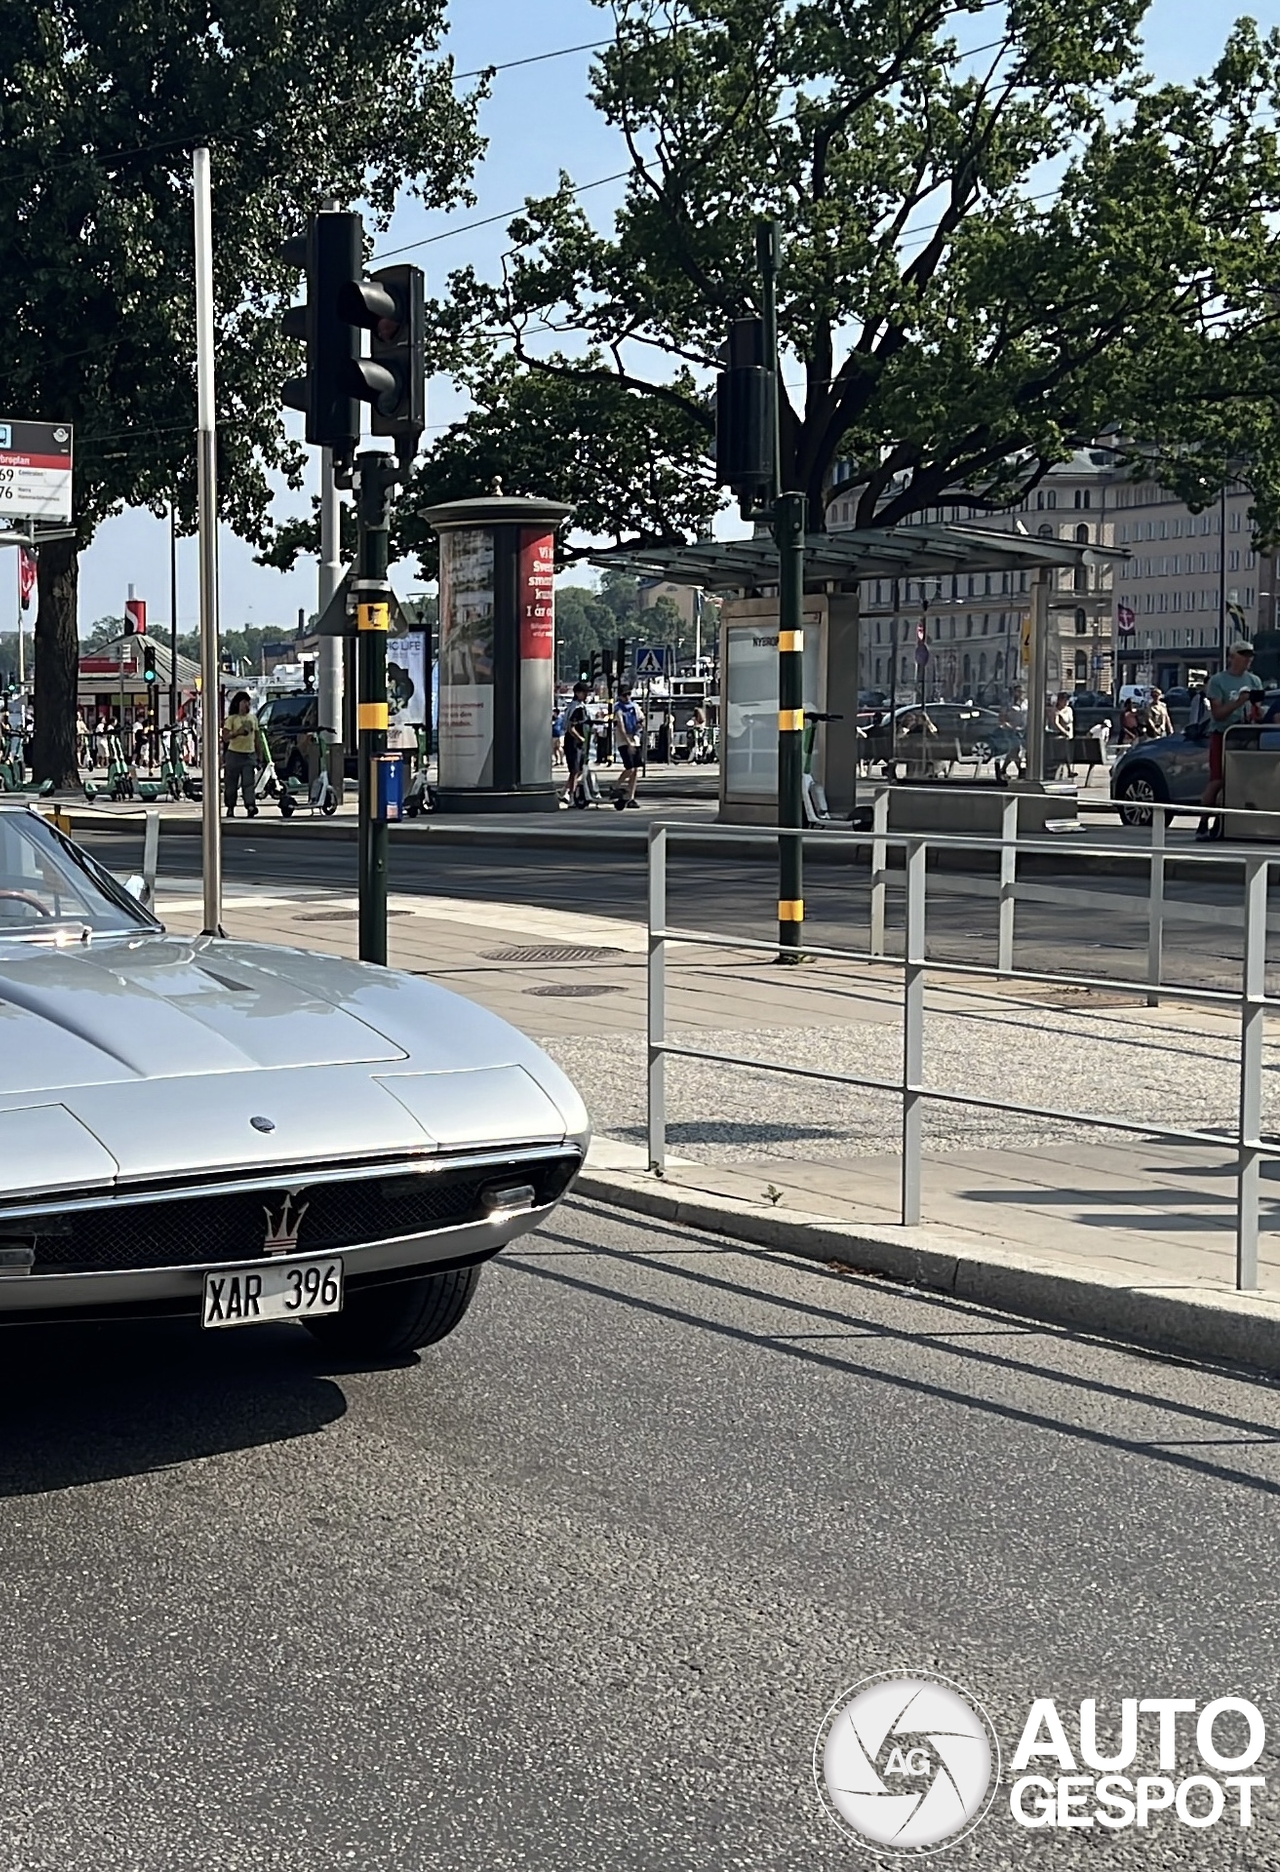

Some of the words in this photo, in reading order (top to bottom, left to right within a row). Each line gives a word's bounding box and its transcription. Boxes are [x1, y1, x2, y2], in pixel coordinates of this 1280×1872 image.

[400, 640, 421, 651] LIFE
[208, 1274, 262, 1322] XAR
[285, 1265, 338, 1310] 396
